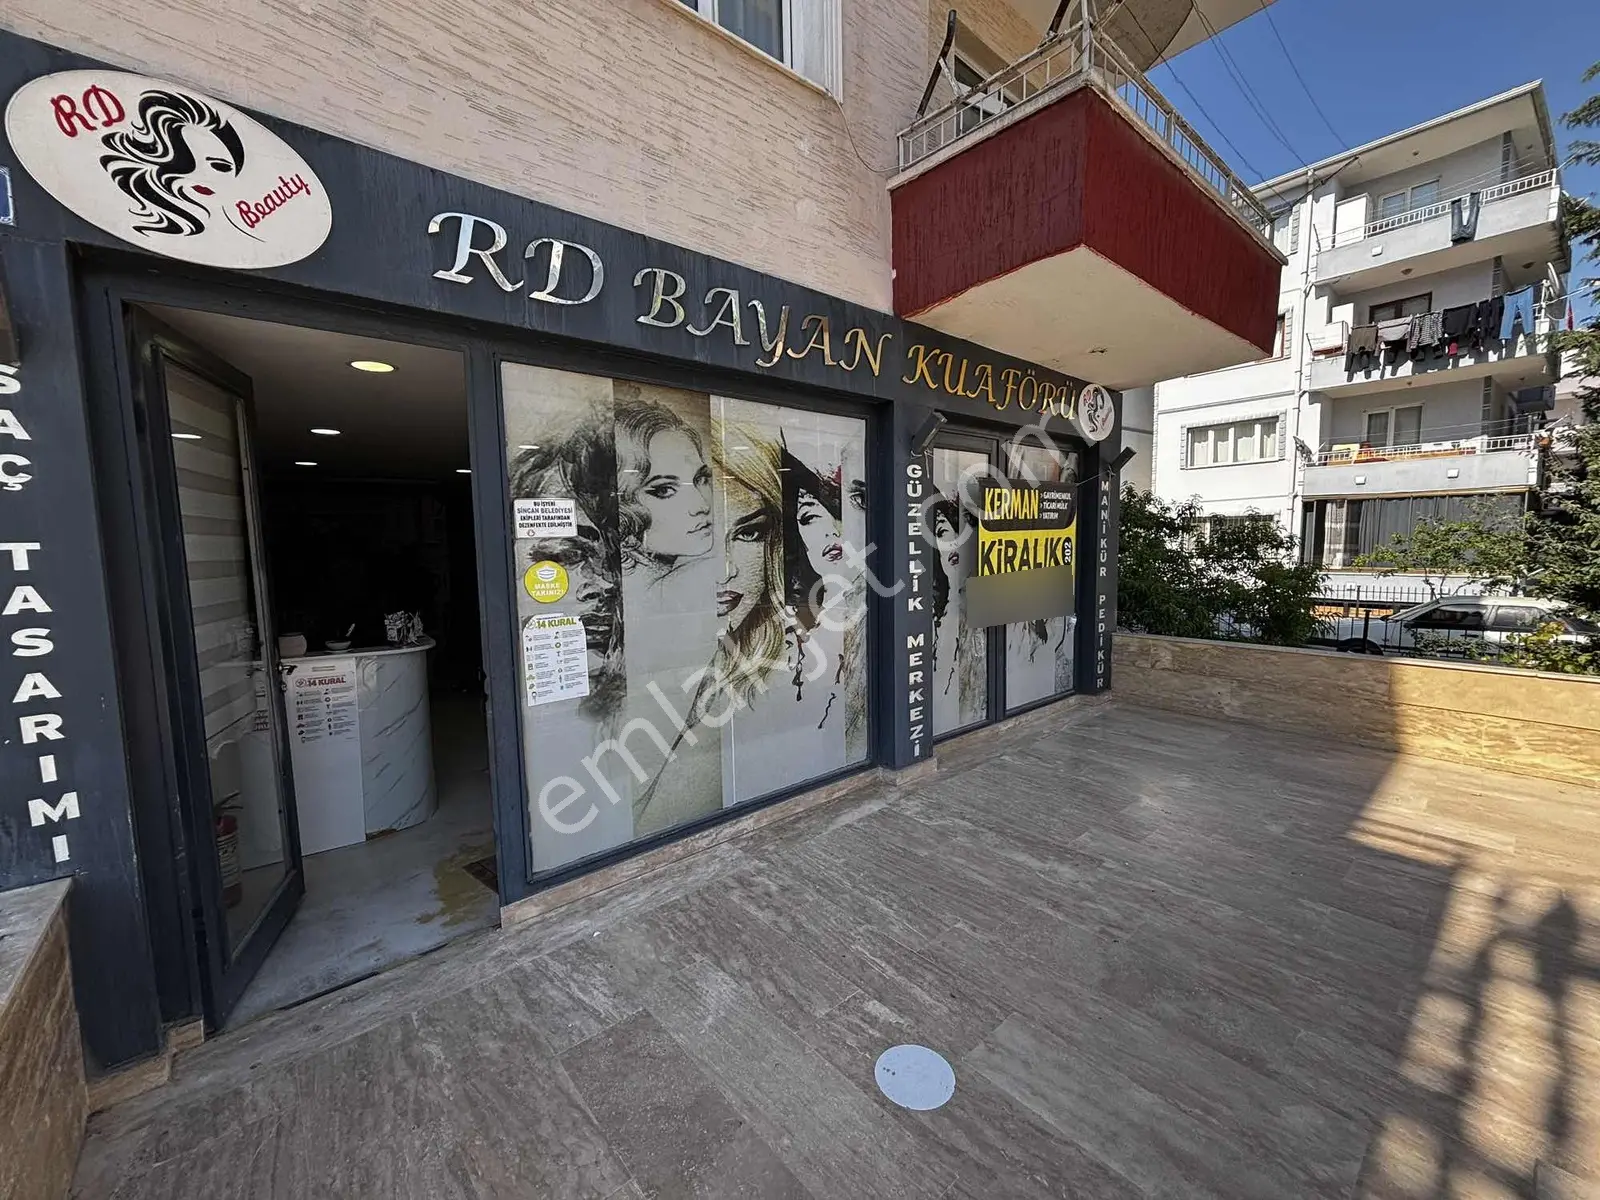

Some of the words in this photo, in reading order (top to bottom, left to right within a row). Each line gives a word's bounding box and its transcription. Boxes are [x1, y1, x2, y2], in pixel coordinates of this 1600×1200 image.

[50, 84, 126, 138] RD
[235, 173, 312, 229] Beauty
[427, 211, 604, 305] RD
[633, 267, 892, 377] BAYAN
[902, 343, 1077, 421] KUAFÖRÜ
[906, 463, 924, 611] GÜZELLİK
[984, 487, 1039, 520] KERMAN
[1100, 481, 1109, 576] MANİKÜR
[980, 537, 1062, 577] KİRALIK
[547, 617, 577, 628] KURAL
[1096, 594, 1106, 689] PEDİKÜR
[0, 541, 82, 863] TASARIMI
[317, 675, 347, 687] KURAL
[906, 633, 925, 757] MERKEZİ
